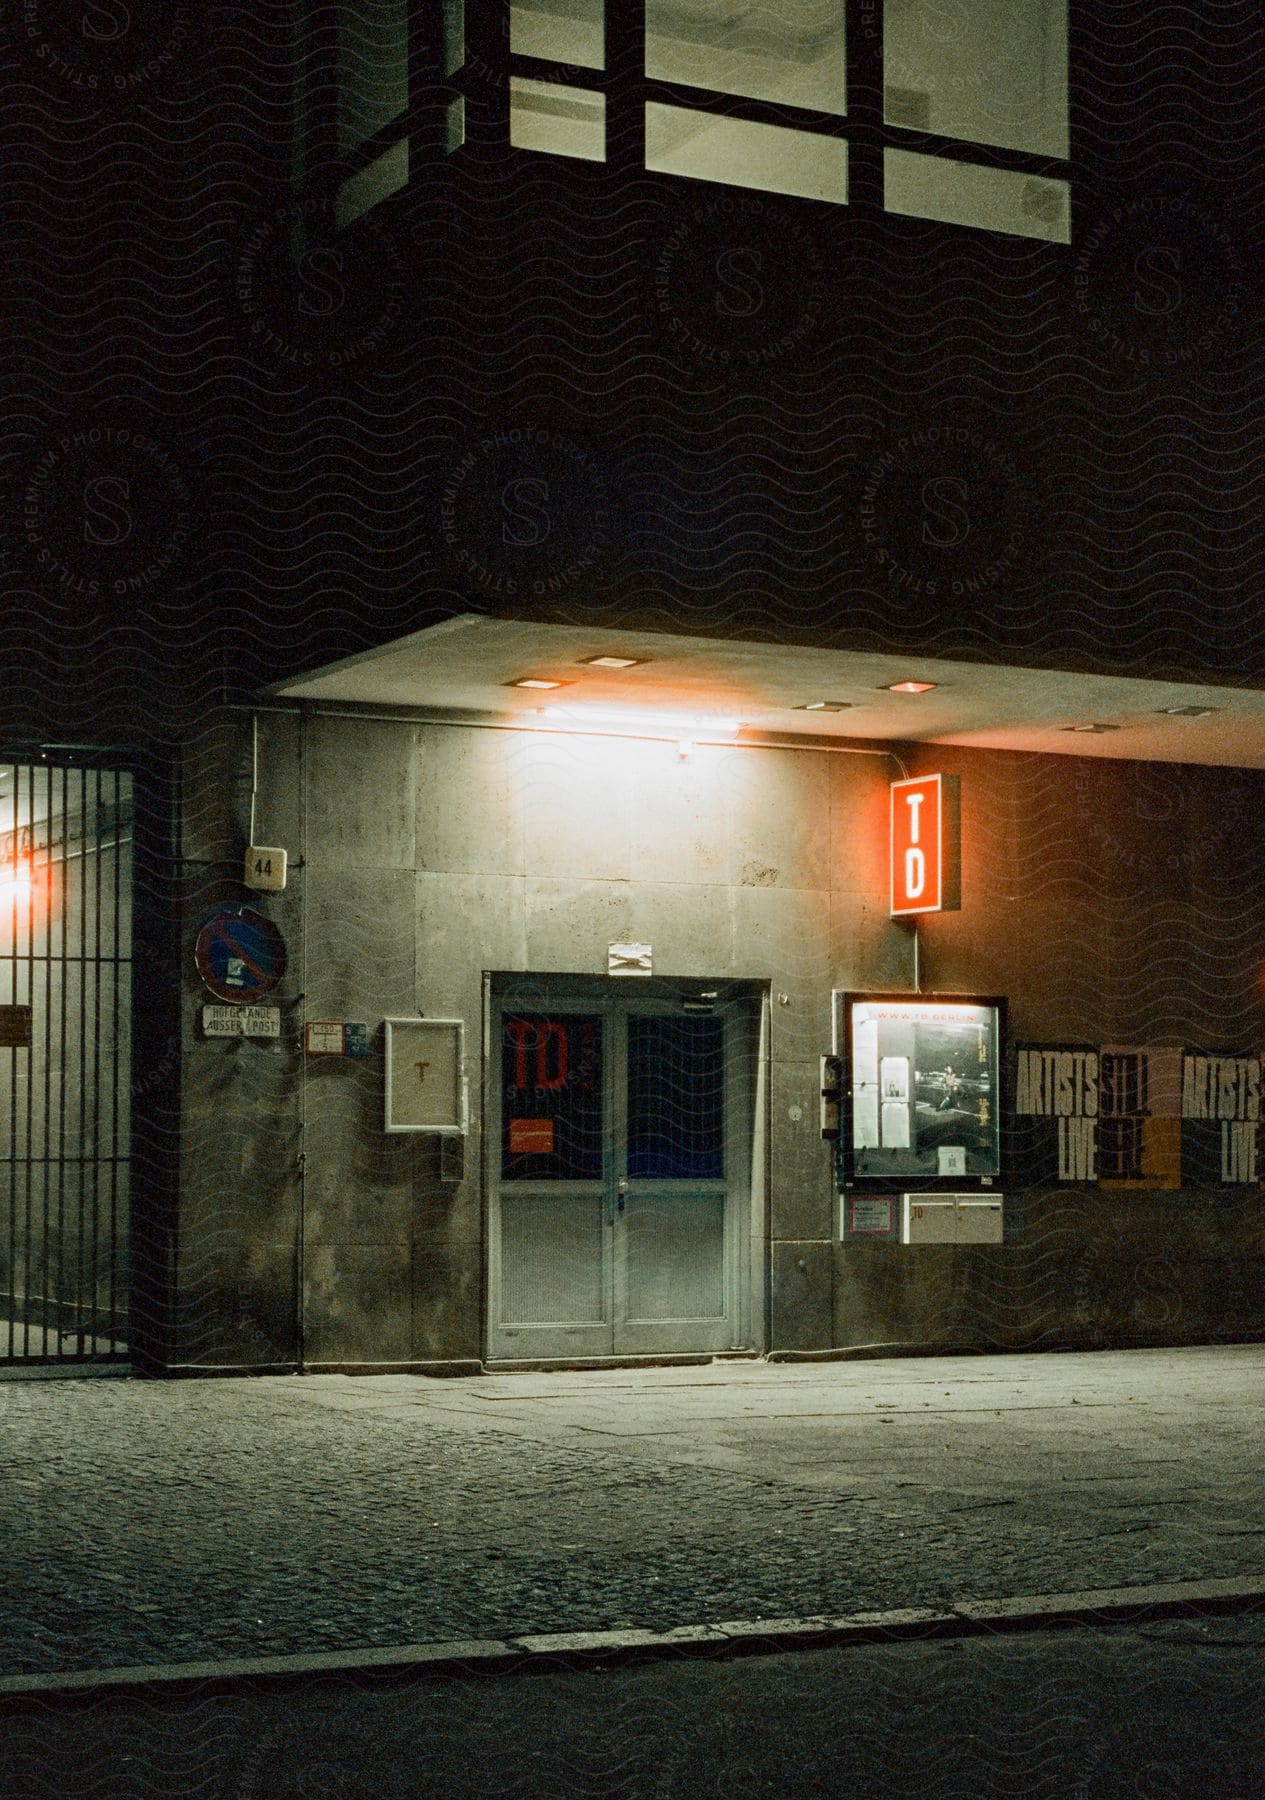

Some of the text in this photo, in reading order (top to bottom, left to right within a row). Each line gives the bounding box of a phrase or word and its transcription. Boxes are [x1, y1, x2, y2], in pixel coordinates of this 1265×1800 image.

[255, 859, 272, 877] 44
[906, 793, 924, 899] TD
[207, 1020, 278, 1033] AUSSER POST
[505, 1022, 569, 1090] TD
[1016, 1050, 1099, 1117] ARTISTS
[1182, 1055, 1261, 1121] ARTISTS
[1058, 1117, 1099, 1181] LIVE
[1221, 1120, 1260, 1183] LIVE
